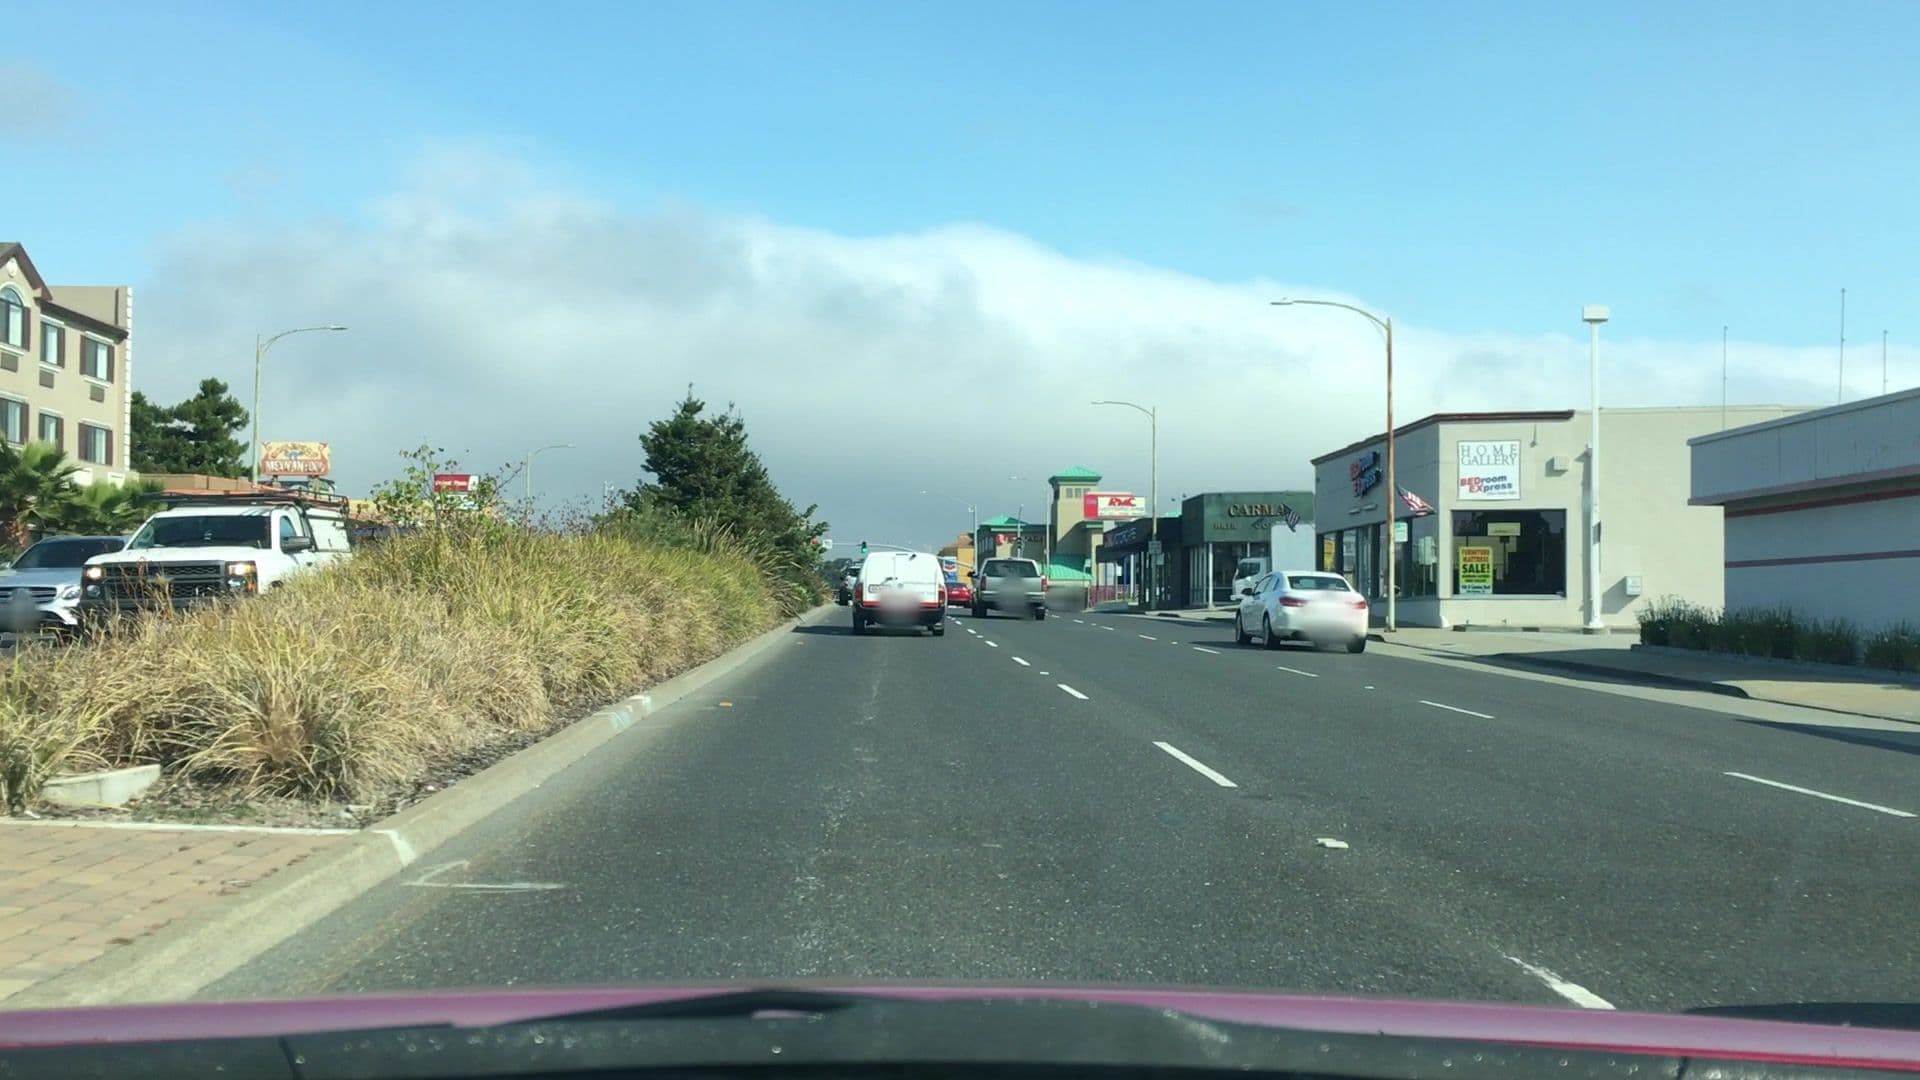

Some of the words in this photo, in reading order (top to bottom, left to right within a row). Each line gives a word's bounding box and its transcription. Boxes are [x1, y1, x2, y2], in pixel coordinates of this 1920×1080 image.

[1460, 444, 1518, 457] HOME
[1461, 454, 1517, 466] GALLERY
[1461, 563, 1491, 574] SALE!
